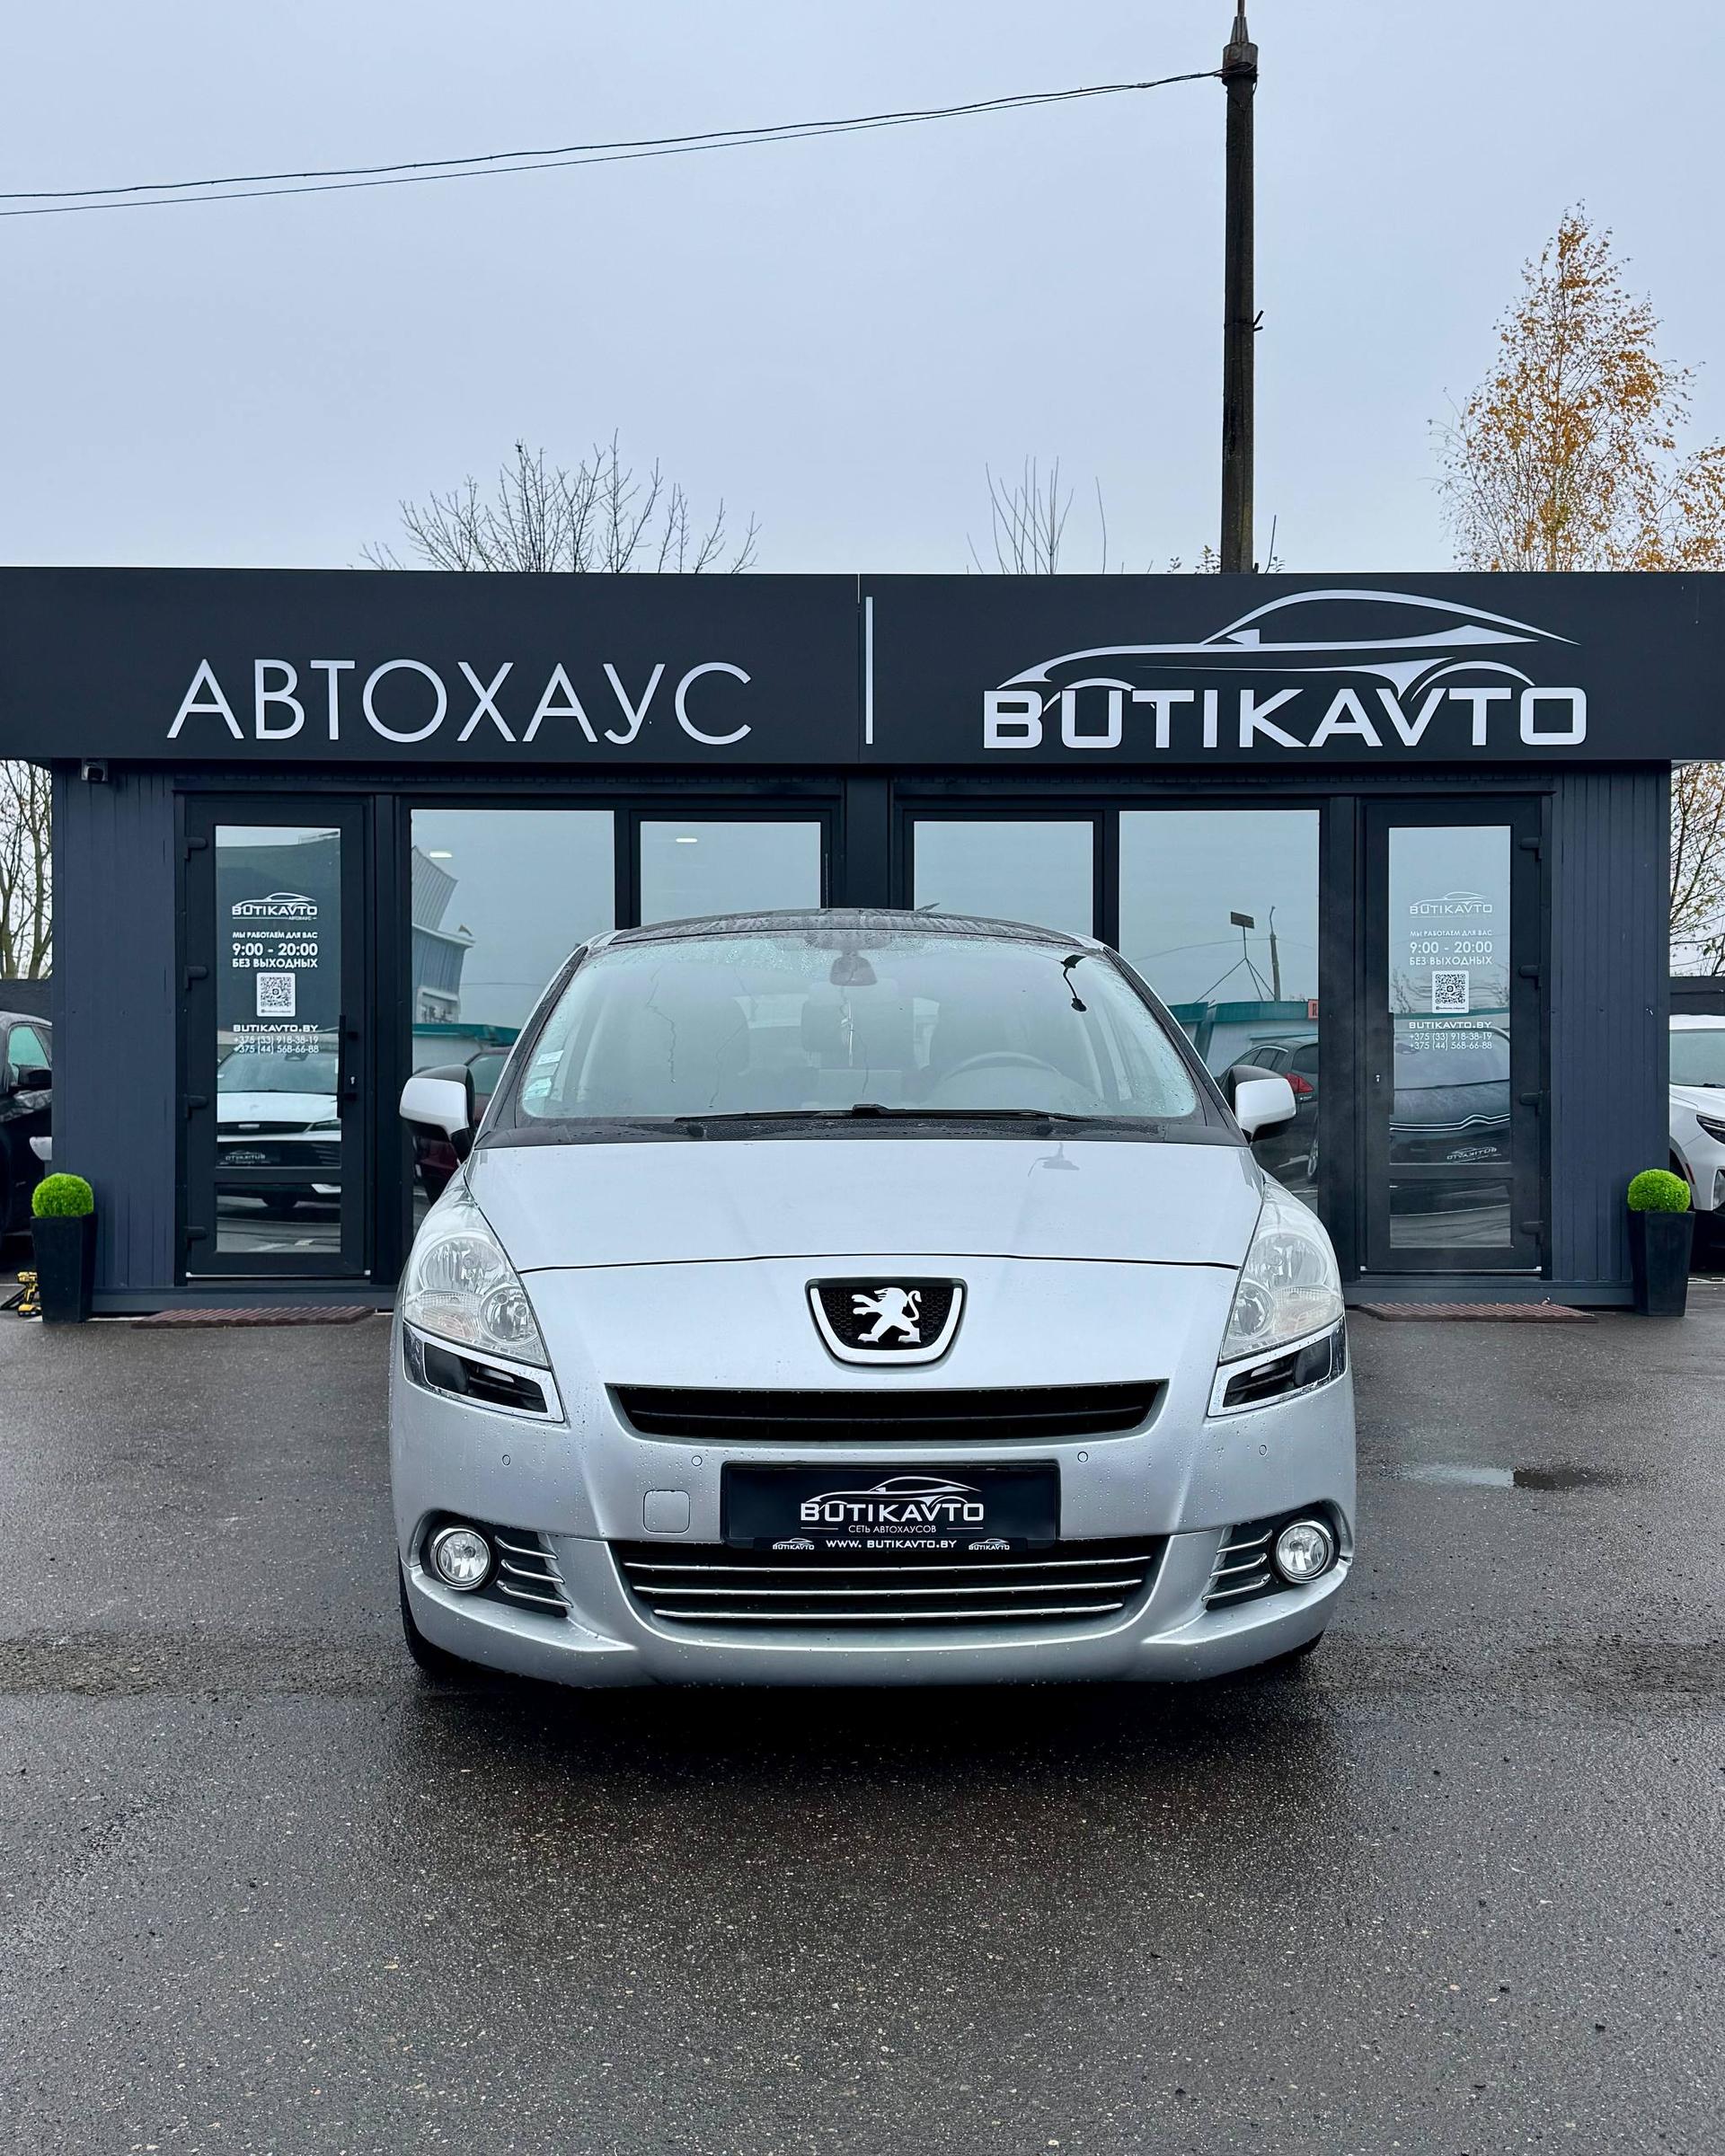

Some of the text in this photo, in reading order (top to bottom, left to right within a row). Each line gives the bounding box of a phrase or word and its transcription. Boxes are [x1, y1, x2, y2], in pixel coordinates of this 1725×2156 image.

[167, 658, 752, 746] АВТОХАУС
[984, 686, 1588, 749] BUTIKAVTO
[232, 906, 317, 915] BUTIKAVTO
[1410, 904, 1492, 915] BUTIKAVTO
[232, 943, 263, 956] 9:00
[278, 943, 318, 956] 20:00
[1410, 941, 1438, 953] 9:00
[1454, 941, 1492, 953] 20:00
[232, 959, 318, 968] БЕЗ ВЫХОДНЫХ
[1410, 956, 1492, 966] БЕЗ ВЫХОДНЫХ
[233, 1024, 318, 1032] BUTIKAVTO.BY
[1409, 1021, 1492, 1029] BUTIKAVTO.BY
[234, 1036, 319, 1045] +375 (33) 918-38-19
[1410, 1032, 1492, 1041] +375 (33) 918-38-19
[257, 1045, 274, 1055] (44)
[277, 1045, 319, 1053] 568-66-88
[1432, 1041, 1448, 1051] (44)
[801, 1502, 984, 1522] BUTIKAVTO
[848, 1524, 936, 1533] СЕТЬ АВТОХАУСОВ
[826, 1540, 958, 1549] WWW. BUTIKAVTO.BY
